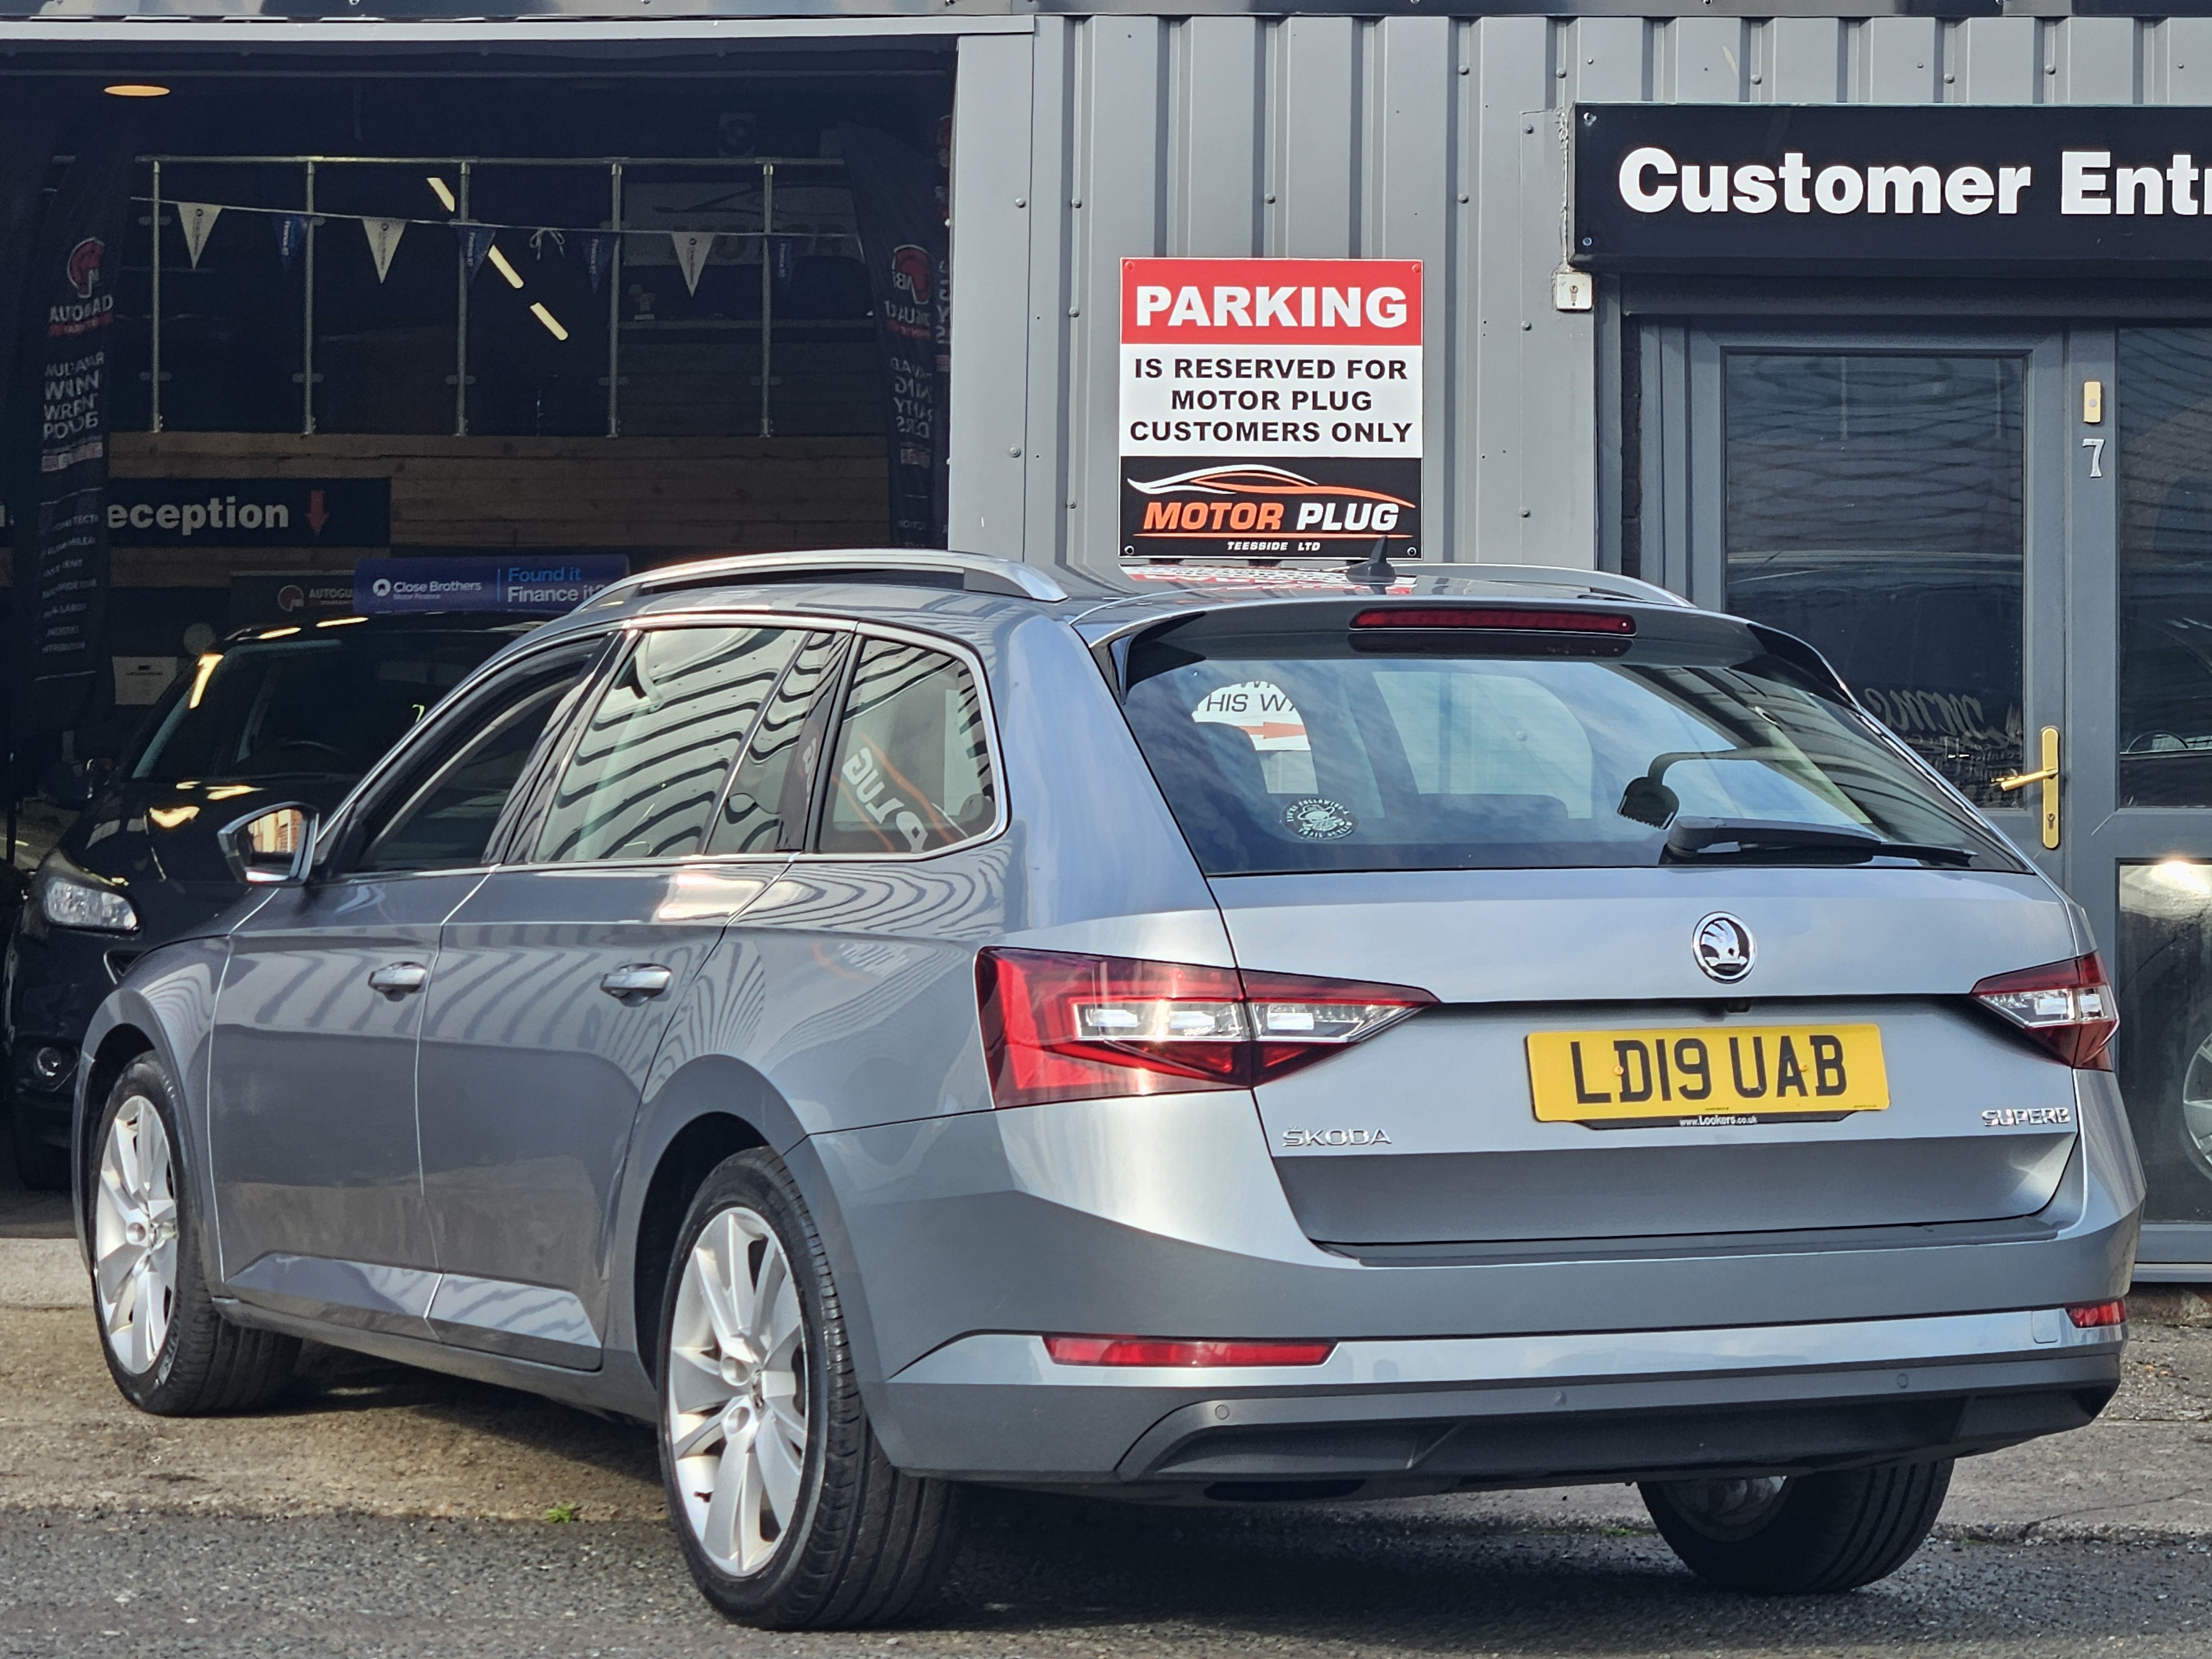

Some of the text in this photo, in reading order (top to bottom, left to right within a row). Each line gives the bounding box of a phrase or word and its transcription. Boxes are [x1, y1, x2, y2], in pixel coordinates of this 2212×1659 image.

[1619, 147, 2031, 215] Customer
[1136, 286, 1407, 328] PARKING
[1135, 358, 1408, 380] IS RESERVED FOR
[1171, 390, 1372, 411] MOTOR PLUG
[1130, 421, 1412, 442] CUSTOMERS ONLY
[2082, 439, 2105, 478] 7
[107, 497, 289, 535] eception
[1143, 502, 1399, 531] MOTOR PLUG
[1227, 541, 1320, 551] TEESSIDE LTD
[508, 567, 581, 582] Found it
[309, 588, 352, 598] AUTOGU
[394, 581, 482, 593] Close Brothers
[508, 586, 578, 602] Finance
[1206, 694, 1248, 712] HIS
[1570, 1035, 1848, 1104] LD19 UAB
[1679, 1114, 1757, 1126] www.Lookers.co.uk
[1982, 1107, 2071, 1126] SUPERB
